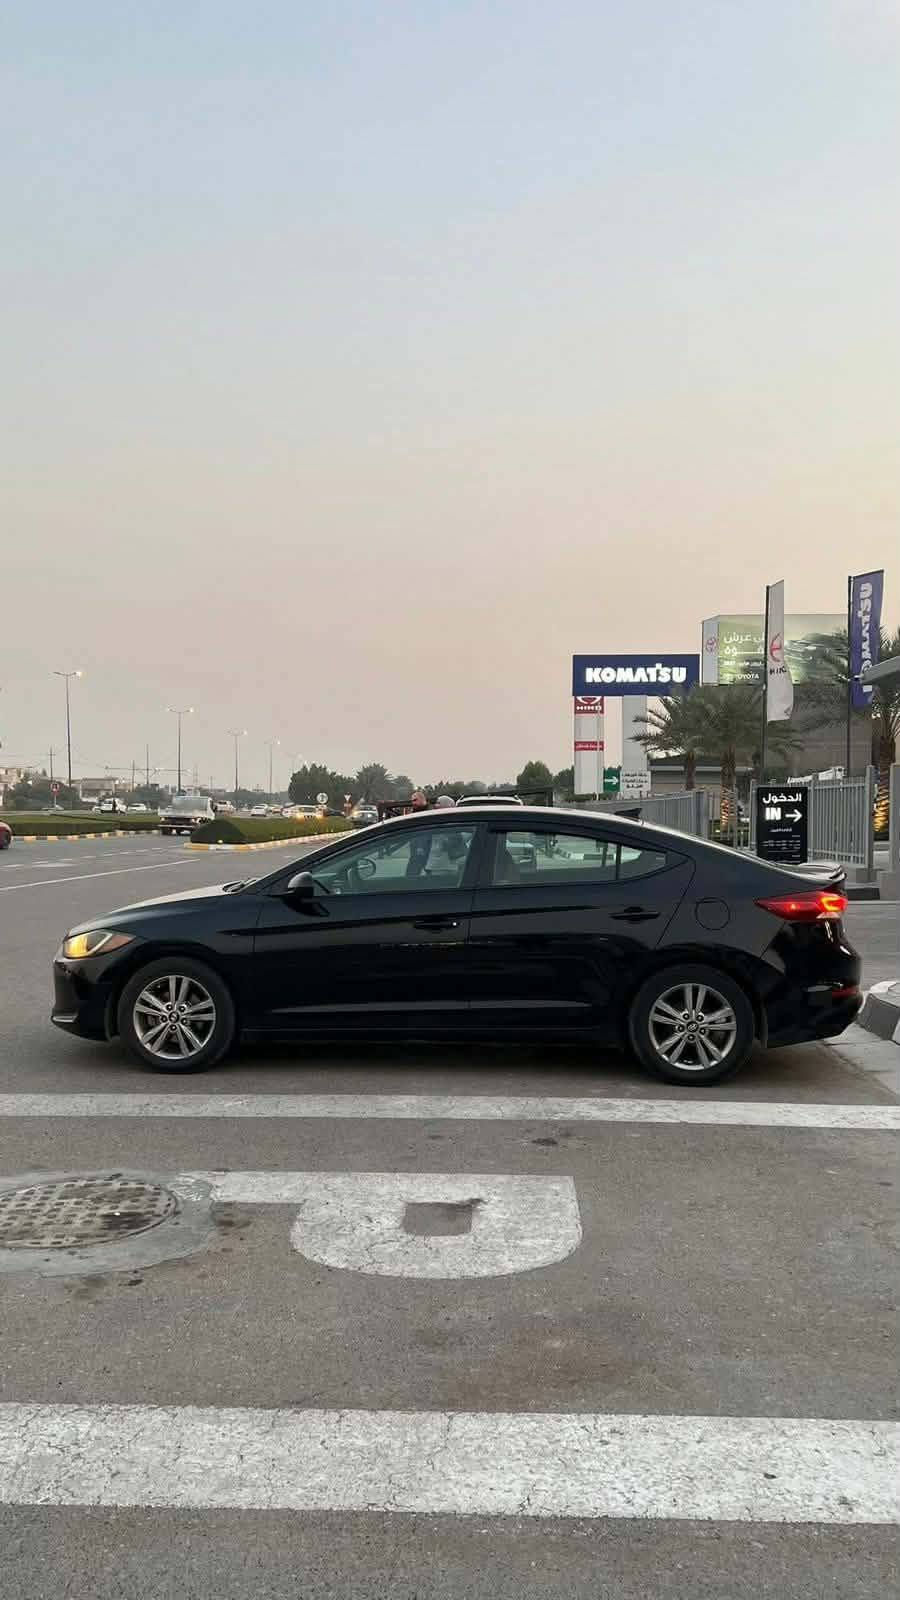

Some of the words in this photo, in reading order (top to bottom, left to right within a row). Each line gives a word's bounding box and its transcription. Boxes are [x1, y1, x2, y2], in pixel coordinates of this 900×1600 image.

[585, 663, 687, 684] KOMATSU
[762, 792, 802, 804] الدخول
[765, 807, 782, 821] IN
